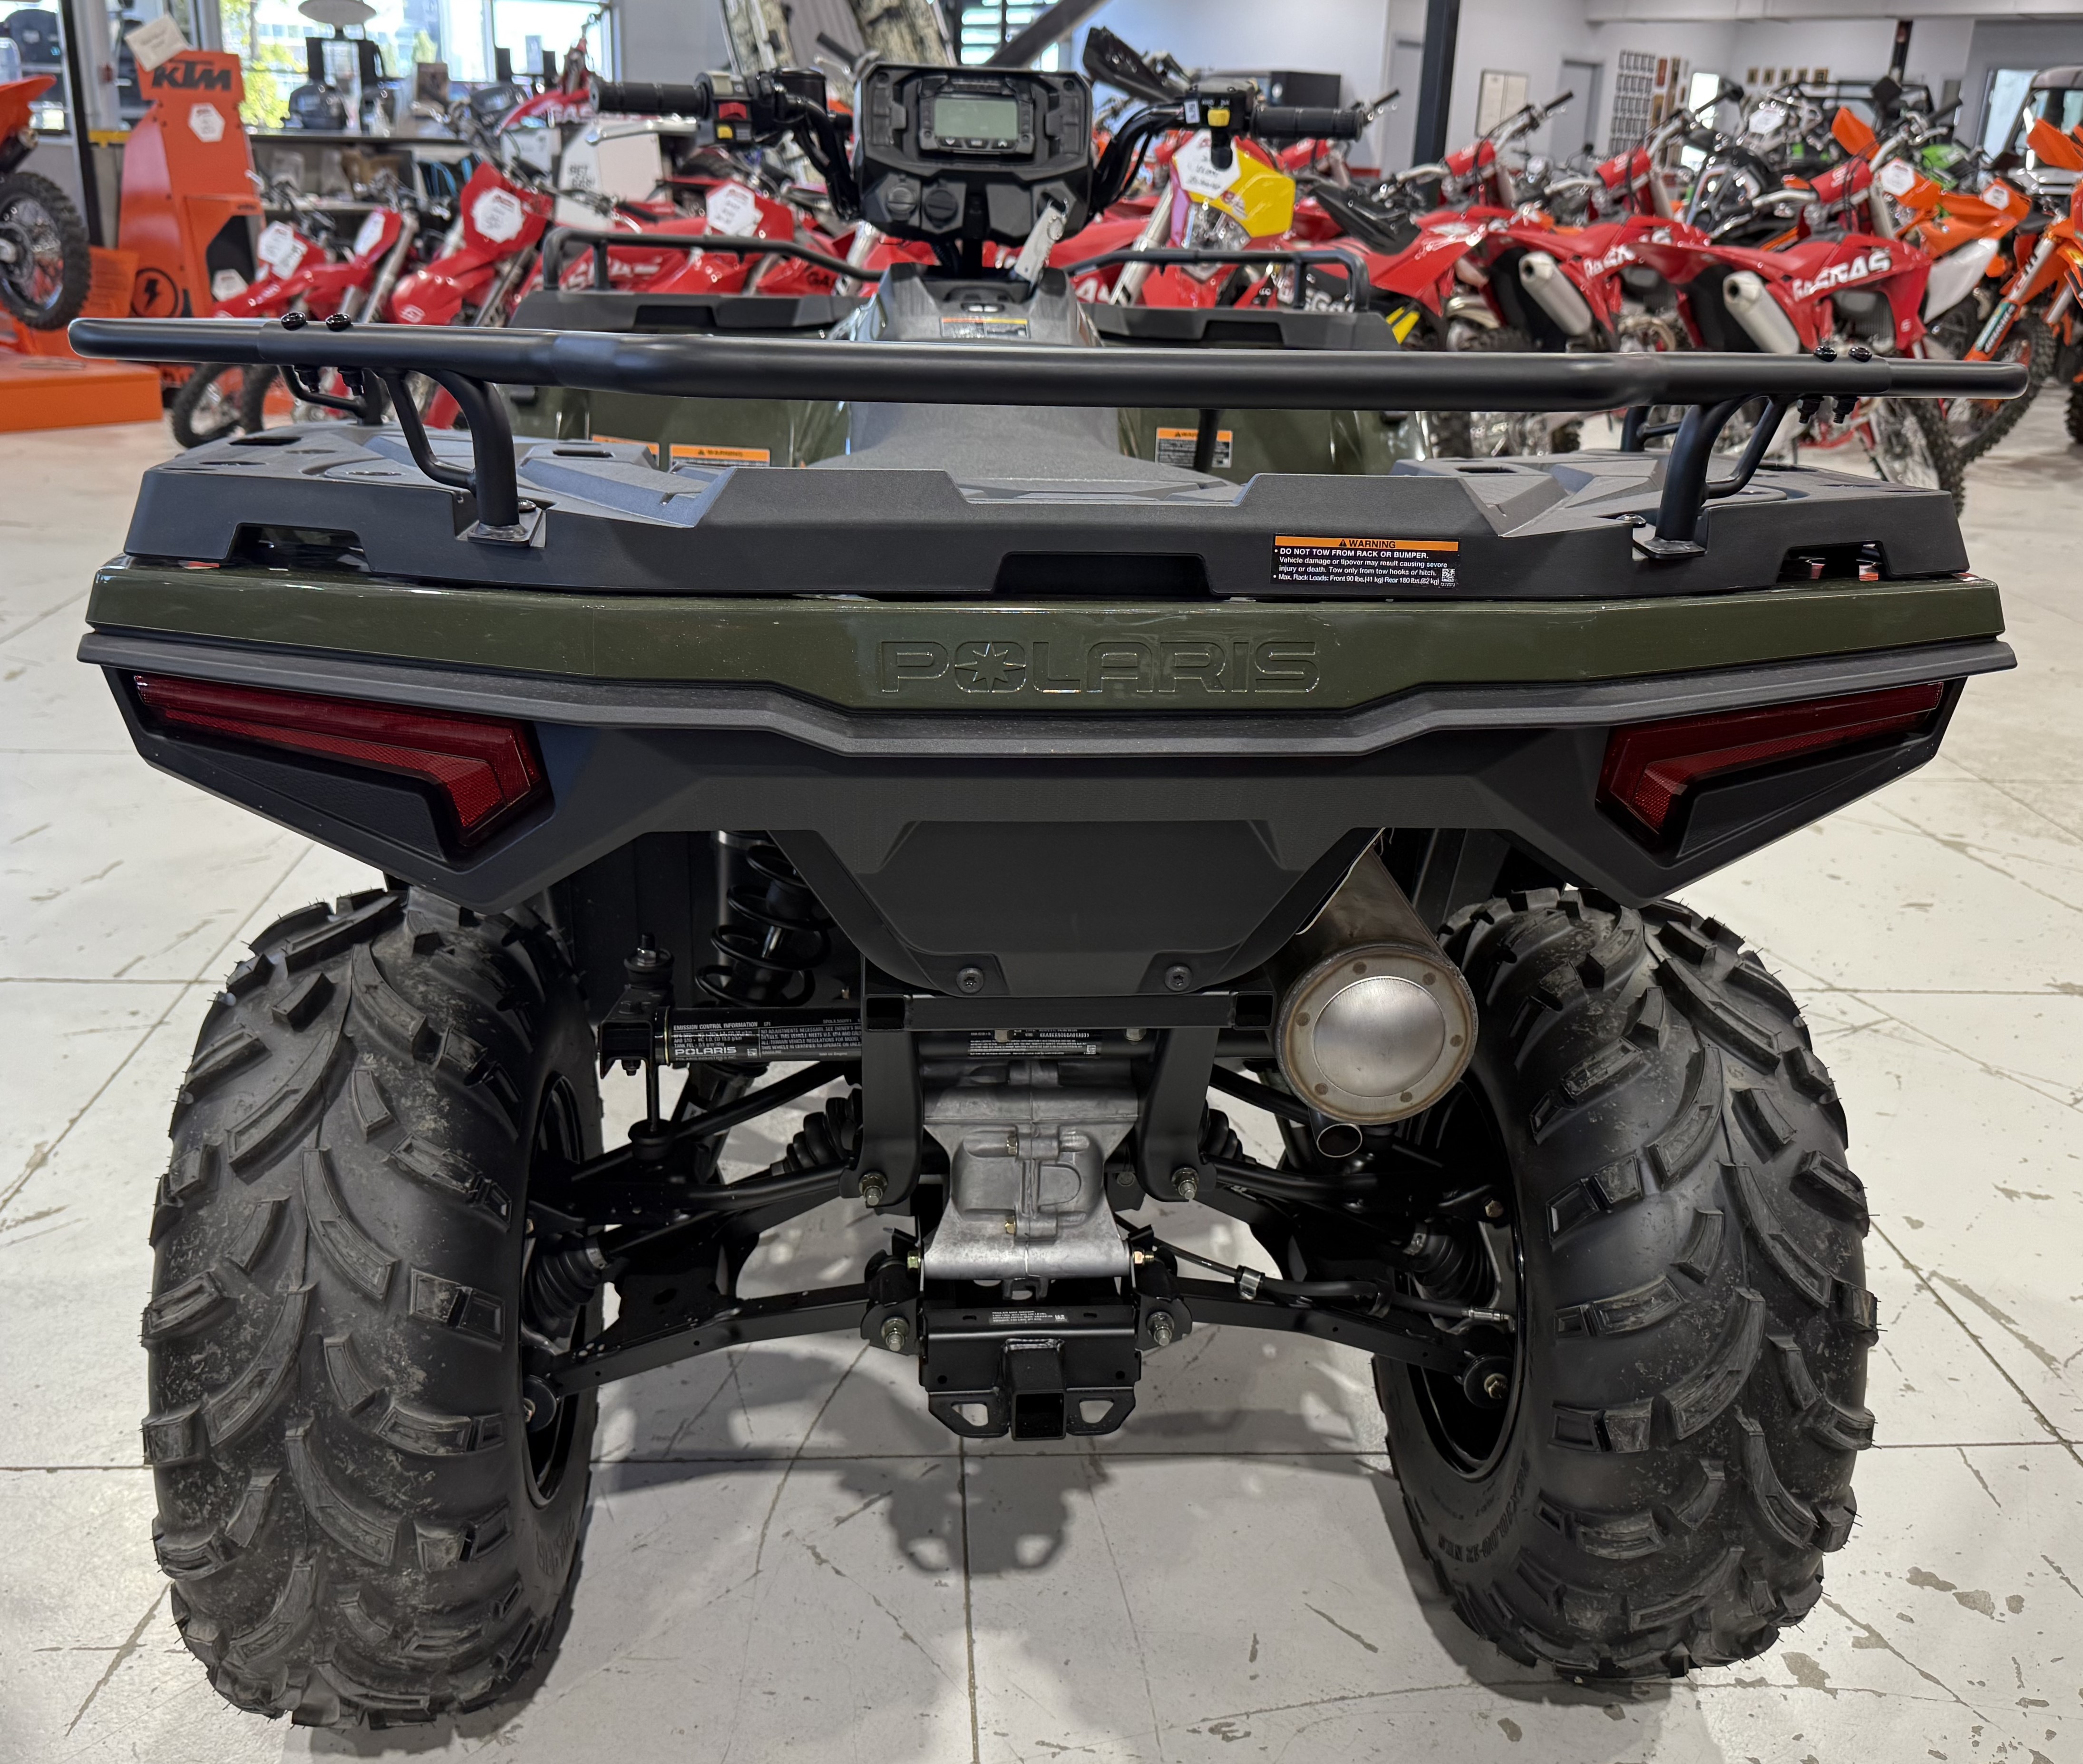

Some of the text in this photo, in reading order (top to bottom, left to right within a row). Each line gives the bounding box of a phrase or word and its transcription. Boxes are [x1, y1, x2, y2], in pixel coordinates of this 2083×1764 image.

[152, 59, 231, 91] KTM
[1349, 539, 1396, 548] WARNING
[879, 641, 1321, 693] POLARIS
[675, 1046, 737, 1055] POLARIS
